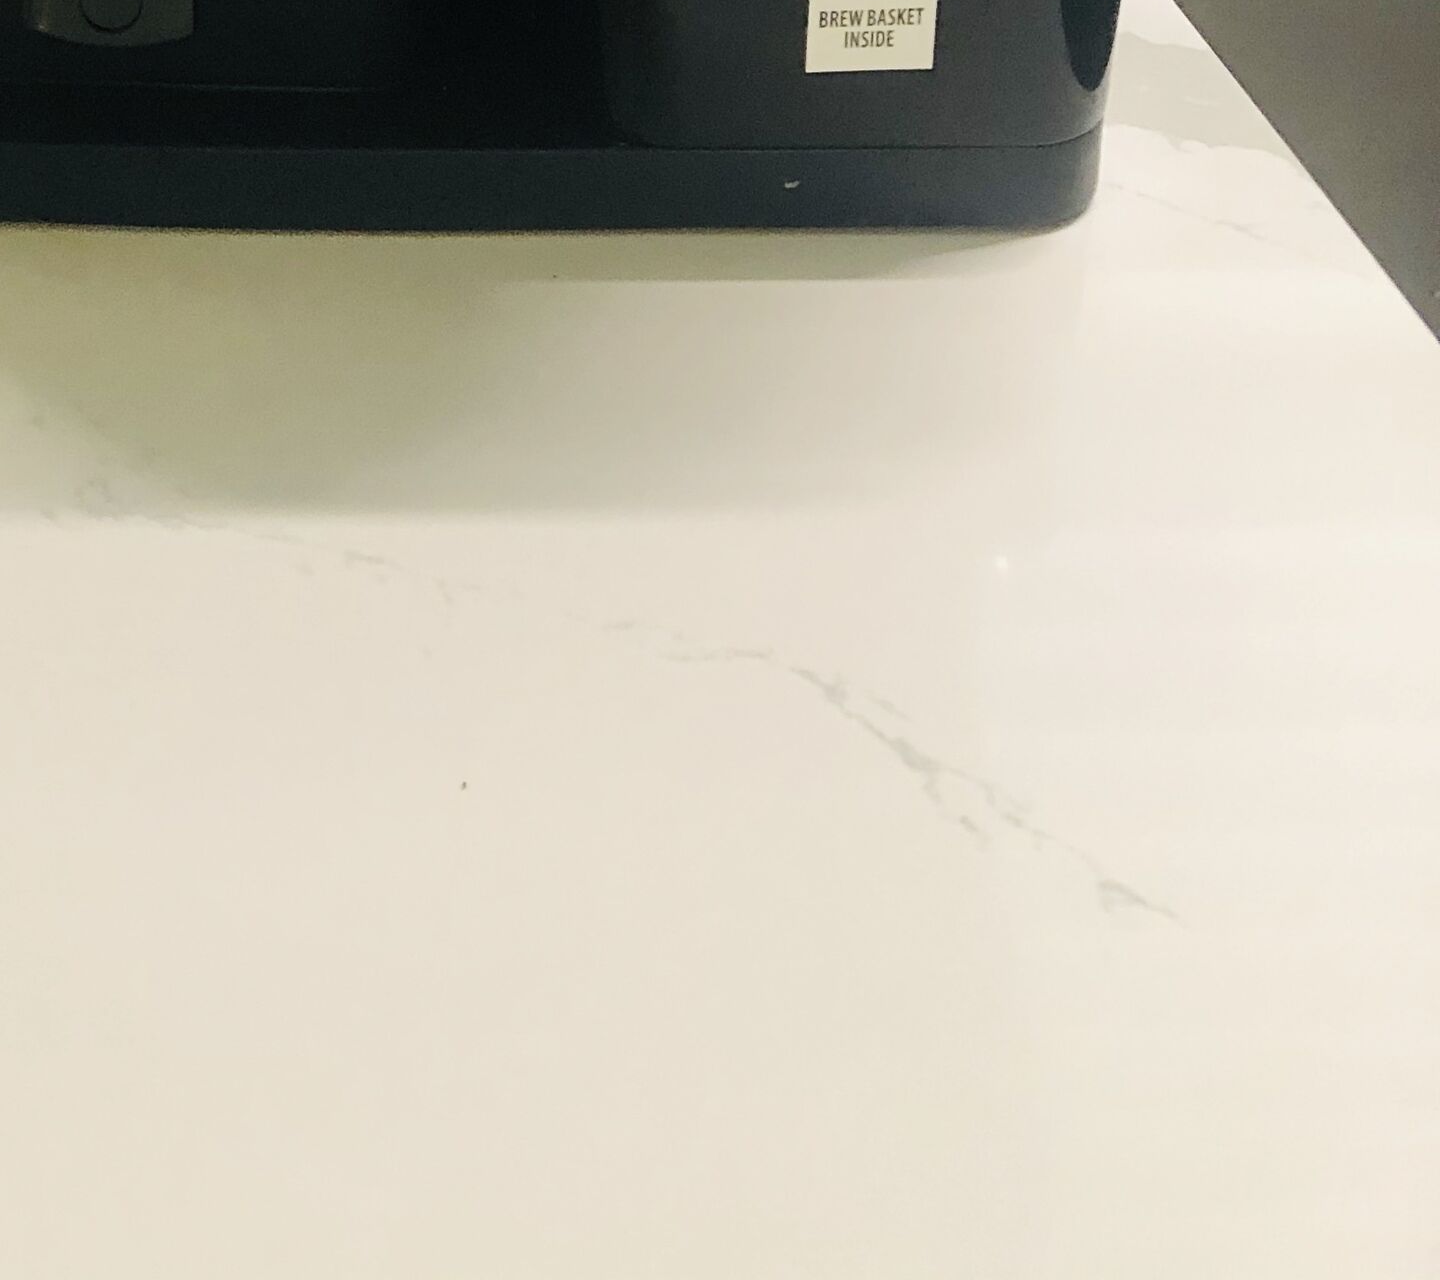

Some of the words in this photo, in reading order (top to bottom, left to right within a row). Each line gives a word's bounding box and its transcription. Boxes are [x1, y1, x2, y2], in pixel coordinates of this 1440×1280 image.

[819, 10, 864, 28] BREW
[867, 7, 924, 27] BASKET
[844, 30, 895, 49] INSIDE
